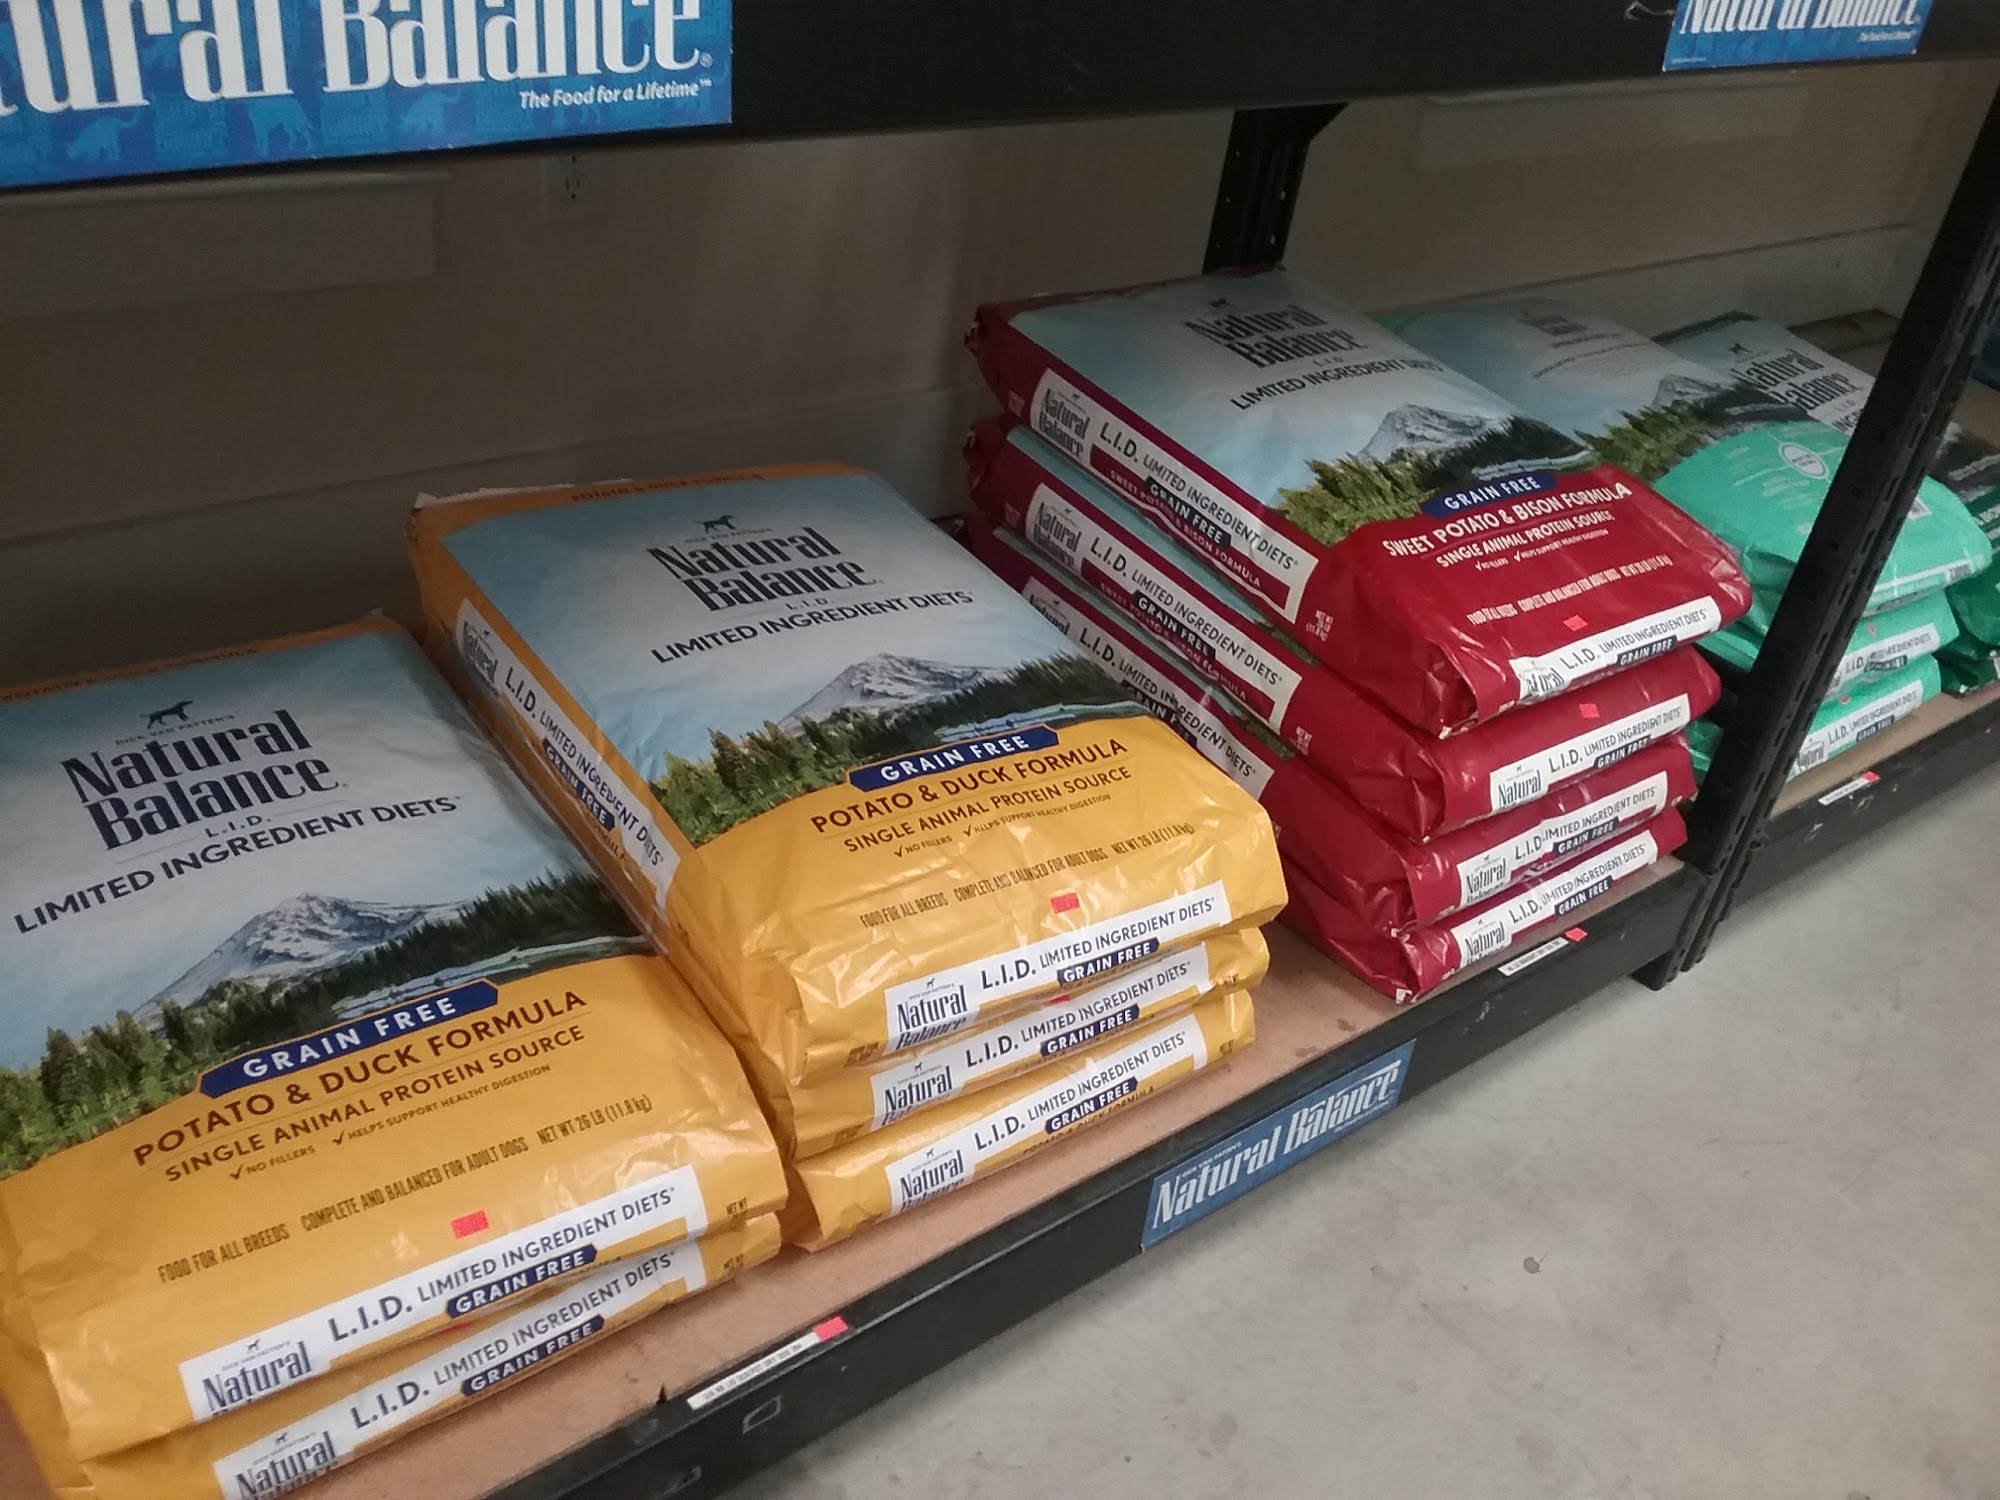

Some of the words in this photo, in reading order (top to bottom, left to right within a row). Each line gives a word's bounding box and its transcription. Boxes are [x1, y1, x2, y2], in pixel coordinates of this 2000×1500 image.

[519, 90, 550, 109] The
[553, 86, 595, 107] Food
[597, 85, 620, 103] for
[622, 87, 634, 101] a
[636, 81, 699, 100] Lifetime
[1184, 304, 1328, 345] Natural
[1225, 328, 1369, 368] Balance
[1040, 388, 1089, 439] Natural
[1230, 377, 1307, 411] LIMITED
[1302, 358, 1405, 386] INGREDIENT
[1038, 418, 1084, 457] Balance
[1099, 421, 1138, 463] L.I.D.
[1143, 452, 1187, 492] LIMITED
[1186, 480, 1259, 550] INGREDIENT
[1257, 539, 1294, 570] DIETS
[1149, 482, 1192, 522] GRAIN
[1193, 517, 1223, 544] FREE
[1382, 533, 1436, 557] SWEET
[1433, 509, 1500, 543] POTATO
[1500, 509, 1515, 525] &
[1514, 496, 1560, 522] BISON
[1563, 482, 1633, 511] FORMULA
[1444, 484, 1500, 511] GRAIN
[1501, 476, 1542, 497] FREE
[647, 526, 841, 579] Natural
[1436, 546, 1484, 569] SINGLE
[1483, 533, 1528, 557] ANIMAL
[1526, 520, 1571, 545] PROTEIN
[1572, 510, 1615, 531] SOURCE
[683, 561, 878, 611] Balance
[786, 597, 836, 610] L.I.D.
[1090, 536, 1128, 578] L.I.D.
[1132, 568, 1174, 607] LIMITED
[1174, 600, 1245, 666] INGREDIENT
[1243, 654, 1279, 685] DIETS
[651, 625, 759, 664] LIMITED
[760, 598, 906, 634] INGREDIENT
[909, 591, 973, 609] DIETS
[1138, 597, 1179, 635] GRAIN
[1181, 630, 1210, 657] FREE
[61, 708, 314, 803] Natural
[505, 667, 536, 718] L.I.D.
[540, 711, 577, 758] LIMITED
[576, 753, 639, 830] INGREDIENT
[636, 826, 660, 866] DIETS
[880, 748, 965, 782] GRAIN
[970, 734, 1030, 760] FREE
[1548, 751, 1583, 774] L.I.D.
[1584, 734, 1617, 757] LIMITED
[1618, 712, 1662, 742] INGREDIENT
[1663, 707, 1681, 725] DIETS
[1598, 749, 1622, 768] GRAIN
[1623, 738, 1649, 756] FREE
[1828, 725, 1849, 744] L.I.D.
[86, 756, 339, 851] Balance
[547, 746, 579, 787] GRAIN
[581, 789, 606, 824] FREE
[810, 790, 914, 833] POTATO
[917, 784, 937, 802] &
[941, 765, 1013, 797] DUCK
[1014, 738, 1128, 779] FORMULA
[843, 821, 914, 853] SINGLE
[919, 799, 990, 832] ANIMAL
[990, 778, 1062, 810] PROTEIN
[1066, 765, 1132, 794] SOURCE
[1498, 771, 1542, 806] Natural
[204, 816, 272, 838] L.I.D.
[14, 868, 155, 934] LIMITED
[160, 808, 366, 880] INGREDIENT
[371, 795, 457, 823] DIETS
[1509, 899, 1542, 924] L.I.D.
[1542, 879, 1574, 905] LIMITED
[1573, 855, 1623, 886] INGREDIENT
[1623, 845, 1646, 864] DIETS
[1558, 893, 1587, 916] GRAIN
[1589, 880, 1610, 898] FREE
[981, 959, 1037, 990] L.I.D.
[1039, 941, 1093, 969] LIMITED
[1095, 914, 1176, 950] INGREDIENT
[1179, 899, 1212, 921] DIETS
[1063, 956, 1112, 983] GRAIN
[1117, 942, 1150, 965] FREE
[1464, 923, 1505, 957] Natural
[242, 1027, 362, 1079] GRAIN
[373, 996, 459, 1039] FREE
[897, 985, 968, 1032] Natural
[965, 1035, 1019, 1068] L.I.D.
[1021, 1013, 1077, 1043] LIMITED
[1079, 978, 1155, 1021] INGREDIENT
[1156, 962, 1188, 986] DIETS
[1047, 1026, 1095, 1054] GRAIN
[1099, 1009, 1133, 1033] FREE
[132, 1092, 277, 1168] POTATO
[286, 1081, 313, 1106] &
[323, 1043, 420, 1096] DUCK
[426, 989, 587, 1056] FORMULA
[164, 1132, 266, 1182] SINGLE
[272, 1097, 376, 1147] ANIMAL
[380, 1057, 485, 1110] PROTEIN
[489, 1024, 586, 1071] SOURCE
[347, 1120, 382, 1142] HELPS
[384, 1100, 438, 1129] SUPPORT
[440, 1081, 490, 1111] HEALTHY
[491, 1062, 551, 1093] DIGESTION
[884, 1065, 953, 1112] Natural
[974, 1114, 1026, 1151] L.I.D.
[1028, 1088, 1076, 1122] LIMITED
[1078, 1049, 1151, 1095] INGREDIENT
[1152, 1032, 1185, 1058] DIETS
[1051, 1102, 1095, 1130] GRAIN
[1099, 1082, 1130, 1108] FREE
[246, 1163, 264, 1177] NO
[268, 1145, 316, 1169] FILLERS
[900, 1150, 964, 1201] Natural
[1152, 1125, 1282, 1230] Natural
[1283, 1060, 1401, 1156] Balance
[157, 1255, 191, 1285] FOOD
[194, 1247, 217, 1273] FOR
[219, 1239, 243, 1266] ALL
[245, 1222, 290, 1259] BREEDS
[301, 1195, 359, 1233] COMPLETE
[360, 1185, 385, 1214] AND
[386, 1162, 443, 1203] BALANCED
[443, 1155, 464, 1184] FOR
[466, 1142, 500, 1175] ADULT
[501, 1135, 529, 1165] DOGS
[327, 1294, 414, 1343] L.I.D.
[417, 1257, 499, 1303] LIMITED
[503, 1209, 618, 1272] INGREDIENT
[622, 1188, 671, 1222] DIETS
[454, 1270, 529, 1314] GRAIN
[535, 1250, 588, 1282] FREE
[352, 1376, 430, 1428] L.I.D.
[433, 1332, 510, 1387] LIMITED
[511, 1279, 622, 1345] INGREDIENT
[625, 1253, 671, 1288] DIETS
[470, 1347, 540, 1395] GRAIN
[547, 1321, 593, 1355] FREE
[202, 1340, 312, 1412] Natural
[235, 1431, 337, 1500] Natural
